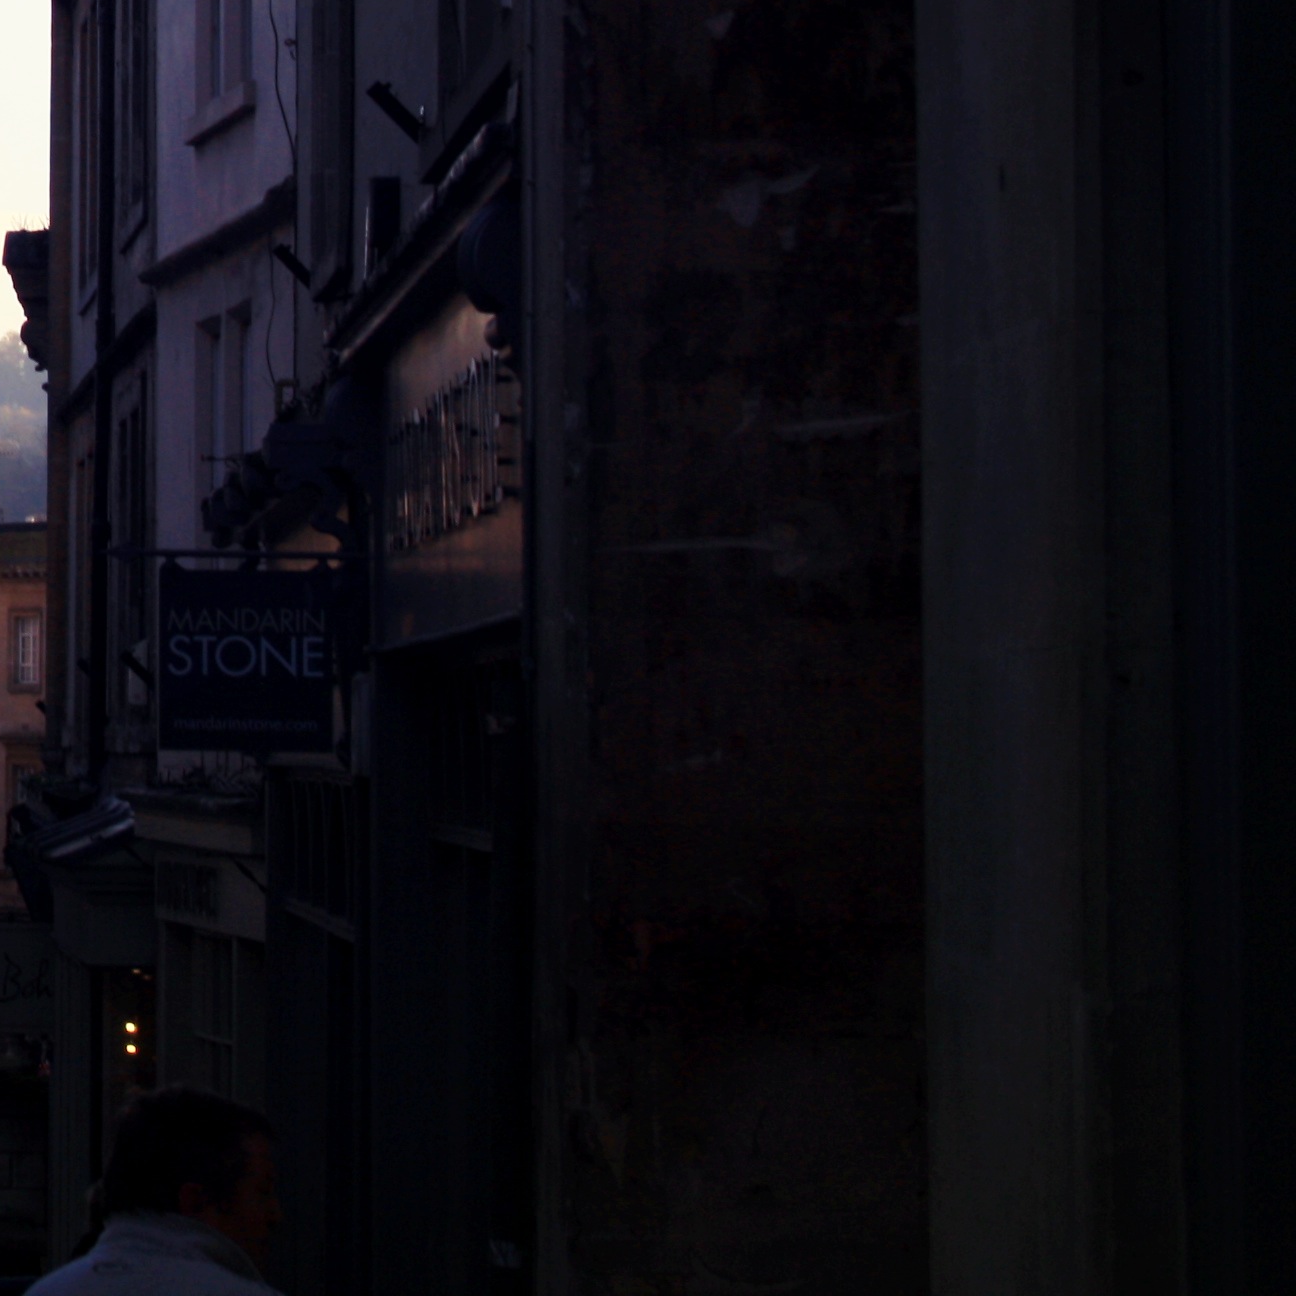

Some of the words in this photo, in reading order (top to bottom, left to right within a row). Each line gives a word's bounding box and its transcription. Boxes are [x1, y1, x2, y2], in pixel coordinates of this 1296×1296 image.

[167, 607, 326, 634] MANDARIN
[167, 634, 325, 678] STONE
[173, 715, 319, 732] mandarinstone.com
